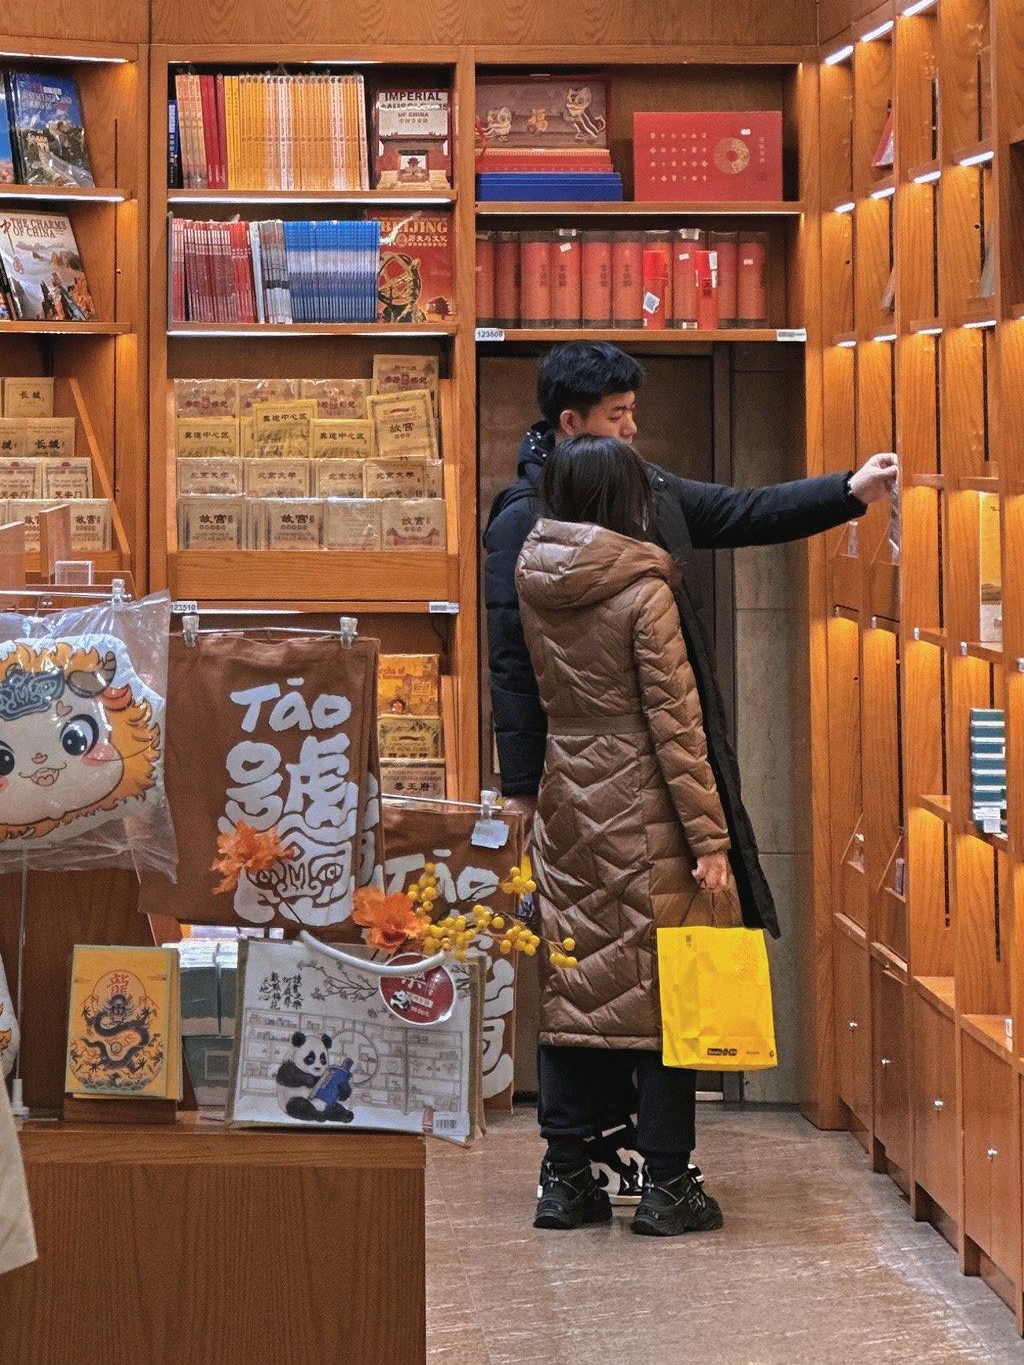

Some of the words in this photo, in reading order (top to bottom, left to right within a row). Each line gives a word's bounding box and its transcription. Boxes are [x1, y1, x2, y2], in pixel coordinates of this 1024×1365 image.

[385, 91, 443, 101] IMPERIAL
[10, 218, 28, 228] THE
[31, 219, 67, 231] CHARMS
[13, 226, 24, 237] OF
[27, 226, 56, 238] CHINA
[389, 423, 414, 433] 故宫
[75, 515, 96, 524] 故宫
[198, 514, 228, 524] 故宫
[280, 514, 309, 524] 故宫
